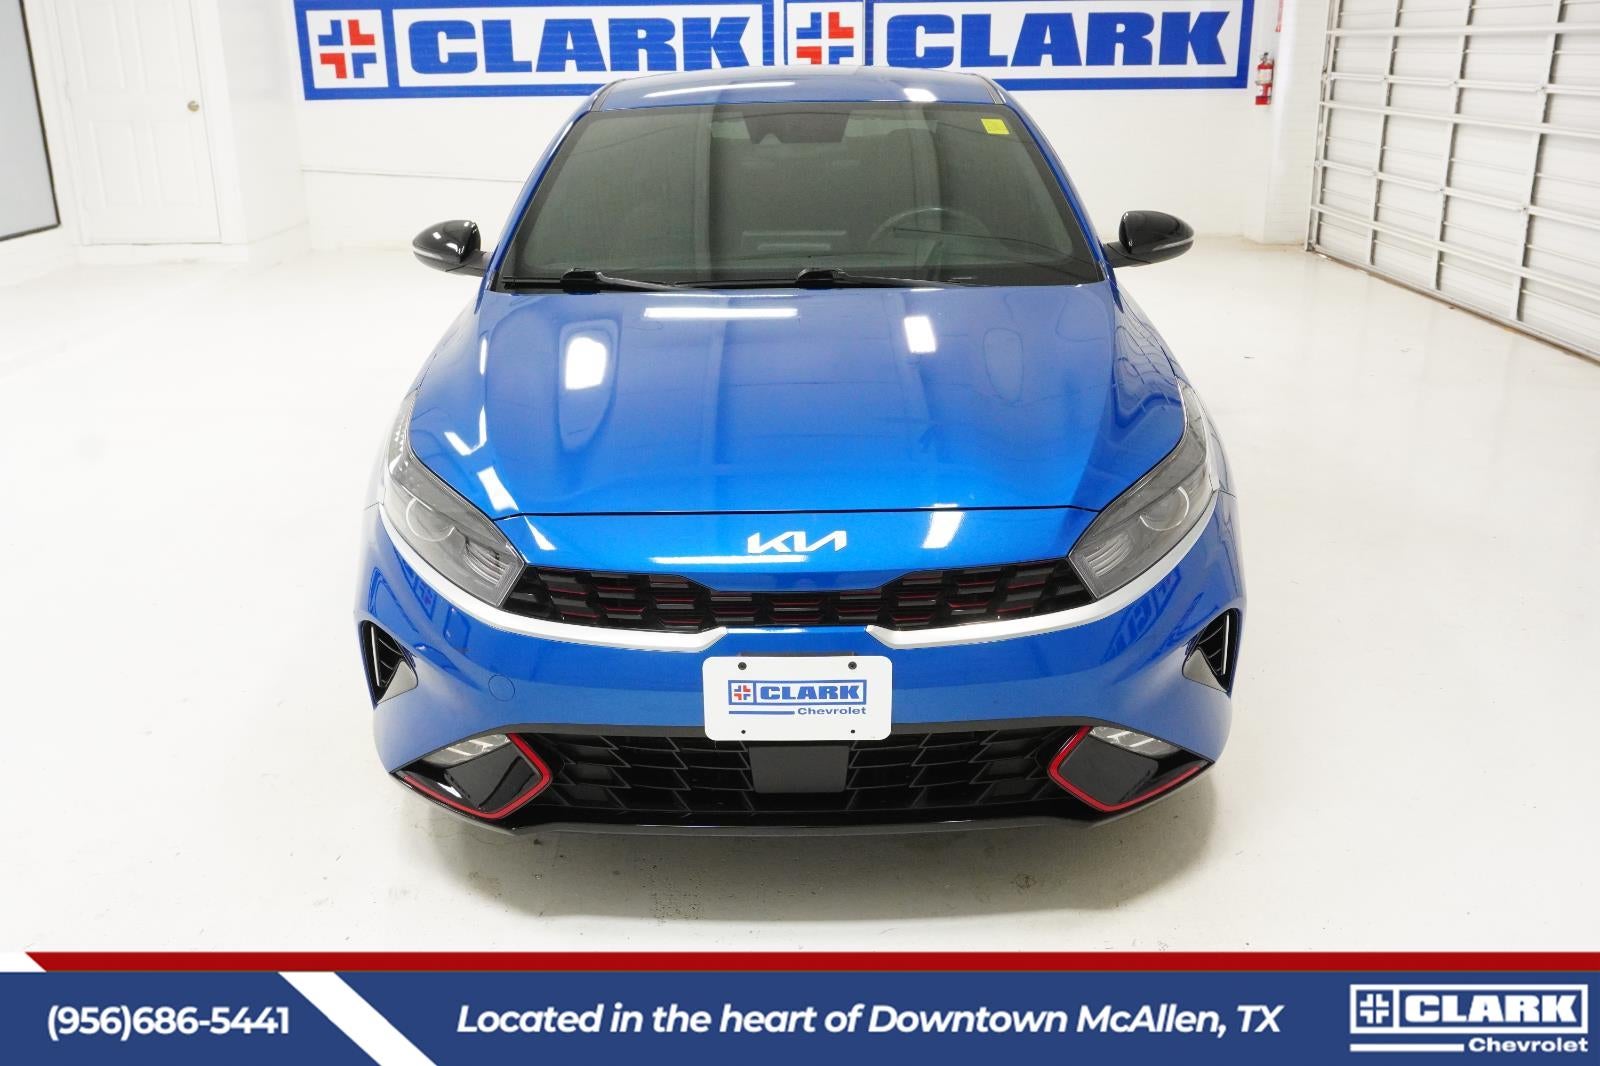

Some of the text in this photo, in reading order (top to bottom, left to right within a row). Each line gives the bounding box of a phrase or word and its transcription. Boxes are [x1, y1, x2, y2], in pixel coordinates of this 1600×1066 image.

[408, 15, 751, 75] CLARK
[886, 11, 1230, 69] CLARK
[759, 684, 861, 701] CLARK
[797, 706, 867, 716] Chevrolet
